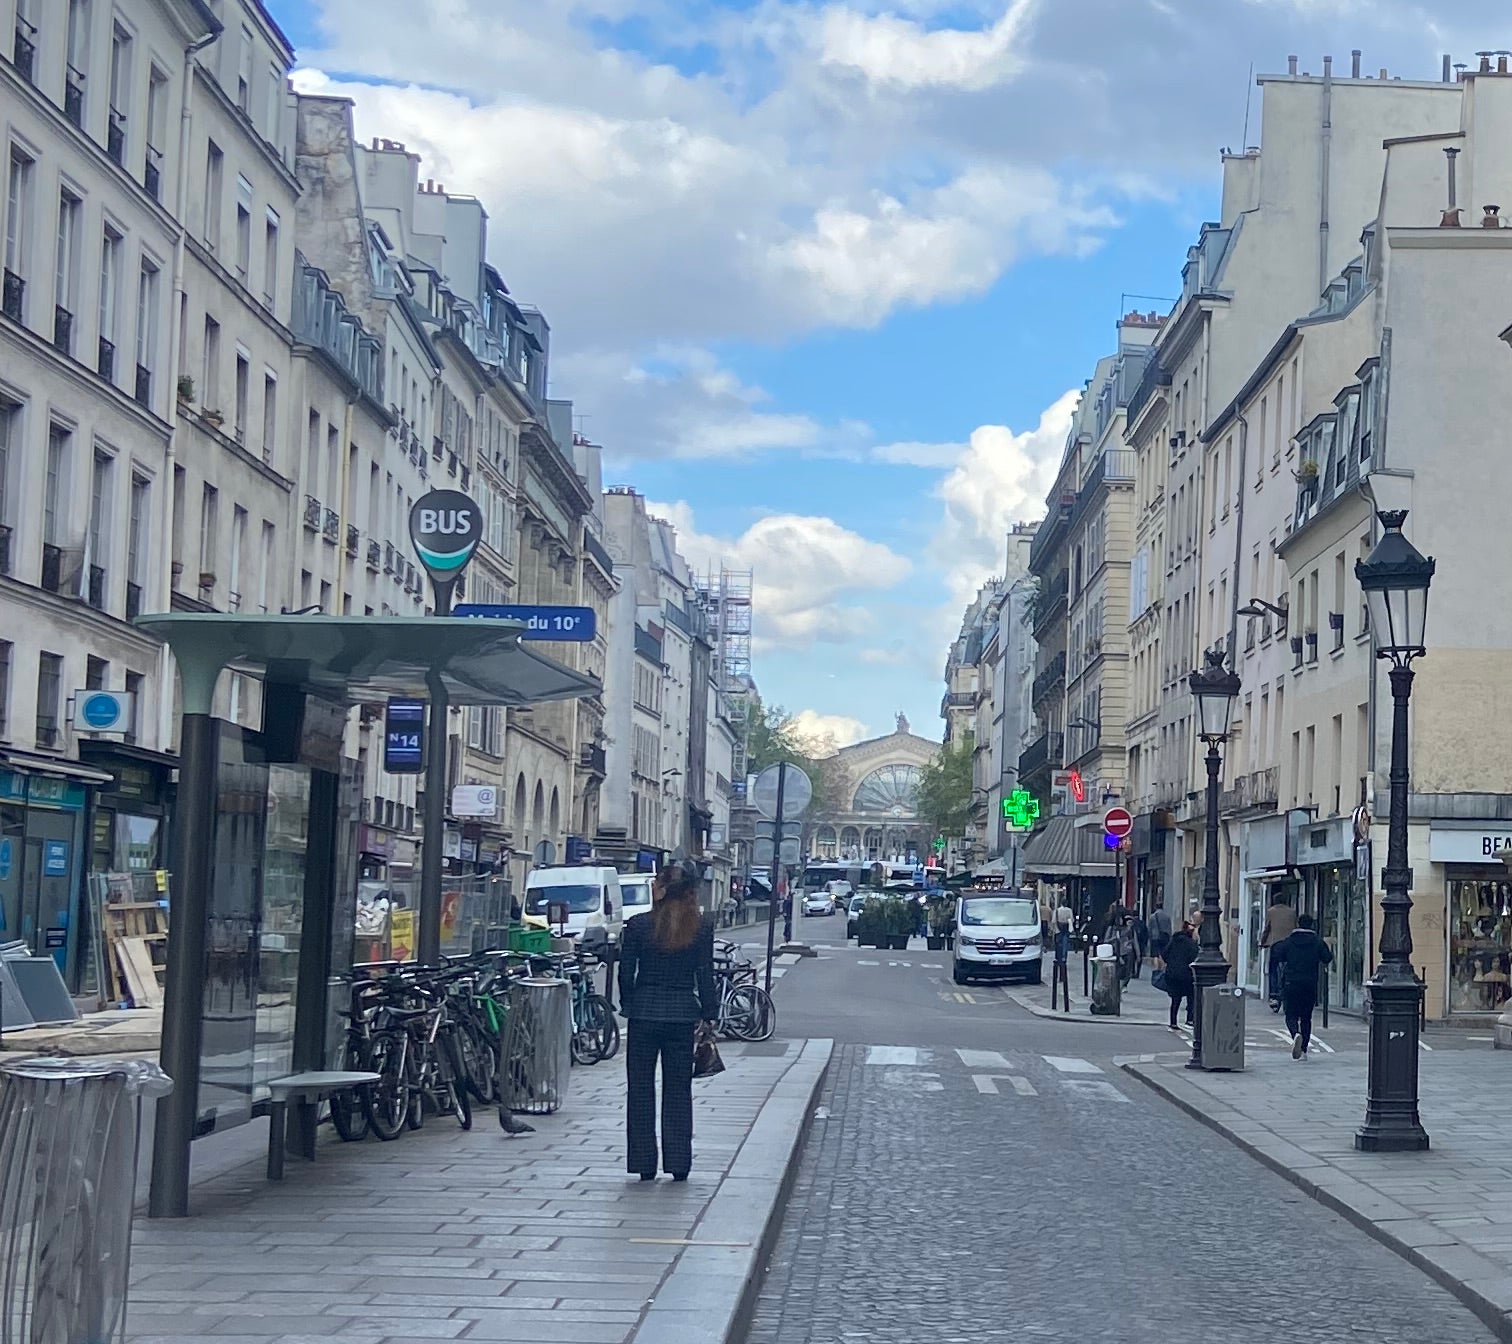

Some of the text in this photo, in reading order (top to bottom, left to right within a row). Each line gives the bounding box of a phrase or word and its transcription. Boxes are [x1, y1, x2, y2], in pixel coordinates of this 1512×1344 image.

[419, 509, 472, 535] BUS
[527, 614, 549, 630] du
[389, 733, 419, 748] N14
